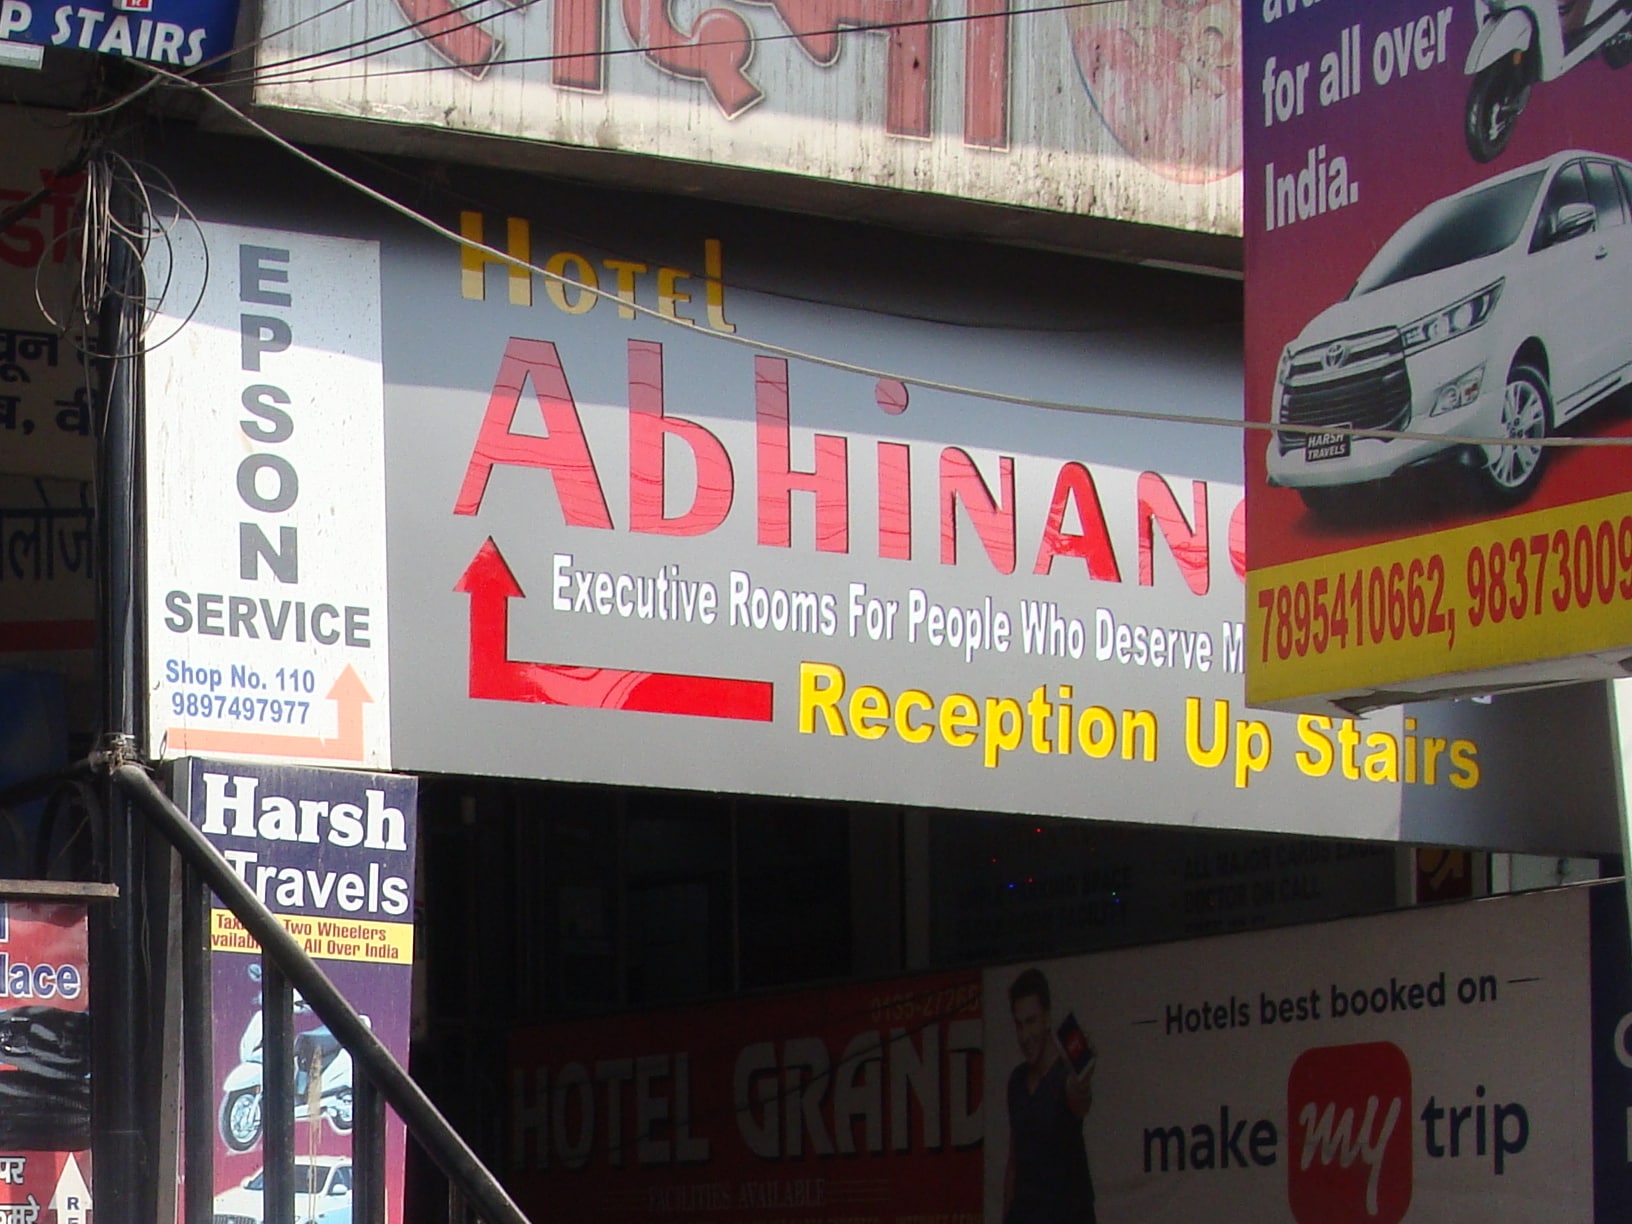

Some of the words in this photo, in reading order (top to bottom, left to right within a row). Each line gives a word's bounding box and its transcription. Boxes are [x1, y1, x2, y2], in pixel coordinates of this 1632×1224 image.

[51, 5, 206, 67] STAIRS
[1262, 55, 1309, 127] for
[1319, 24, 1361, 109] all
[1373, 4, 1453, 80] over
[1265, 143, 1359, 232] India.
[236, 244, 299, 584] EPSON
[1308, 445, 1346, 461] TRAVELS
[164, 590, 371, 649] SERVICE
[552, 553, 718, 625] Executive
[729, 570, 838, 637] Rooms
[849, 583, 900, 640] For
[909, 588, 1011, 662] People
[1021, 600, 1086, 660] Who
[1096, 607, 1213, 673] Deserve
[1258, 553, 1456, 664] 7895410662,
[166, 659, 222, 692] Shop
[230, 660, 267, 690] No.
[275, 666, 316, 694] 110
[171, 692, 311, 727] 9897497977
[799, 660, 1157, 768] Reception
[1185, 695, 1273, 789] Up
[1296, 713, 1482, 791] Stairs
[202, 773, 408, 853] Harsh
[223, 850, 410, 916] Travels
[283, 919, 312, 936] Two
[318, 921, 386, 942] Wheelers
[304, 938, 322, 954] All
[328, 939, 360, 957] Over
[365, 943, 399, 960] India
[1165, 996, 1250, 1036] Hotels
[1261, 988, 1321, 1025] best
[1331, 972, 1445, 1019] booked
[1458, 973, 1498, 1004] on
[512, 1051, 711, 1171] HOTEL
[1143, 1104, 1278, 1173] make
[1298, 1095, 1401, 1217] my
[1420, 1085, 1530, 1175] trip
